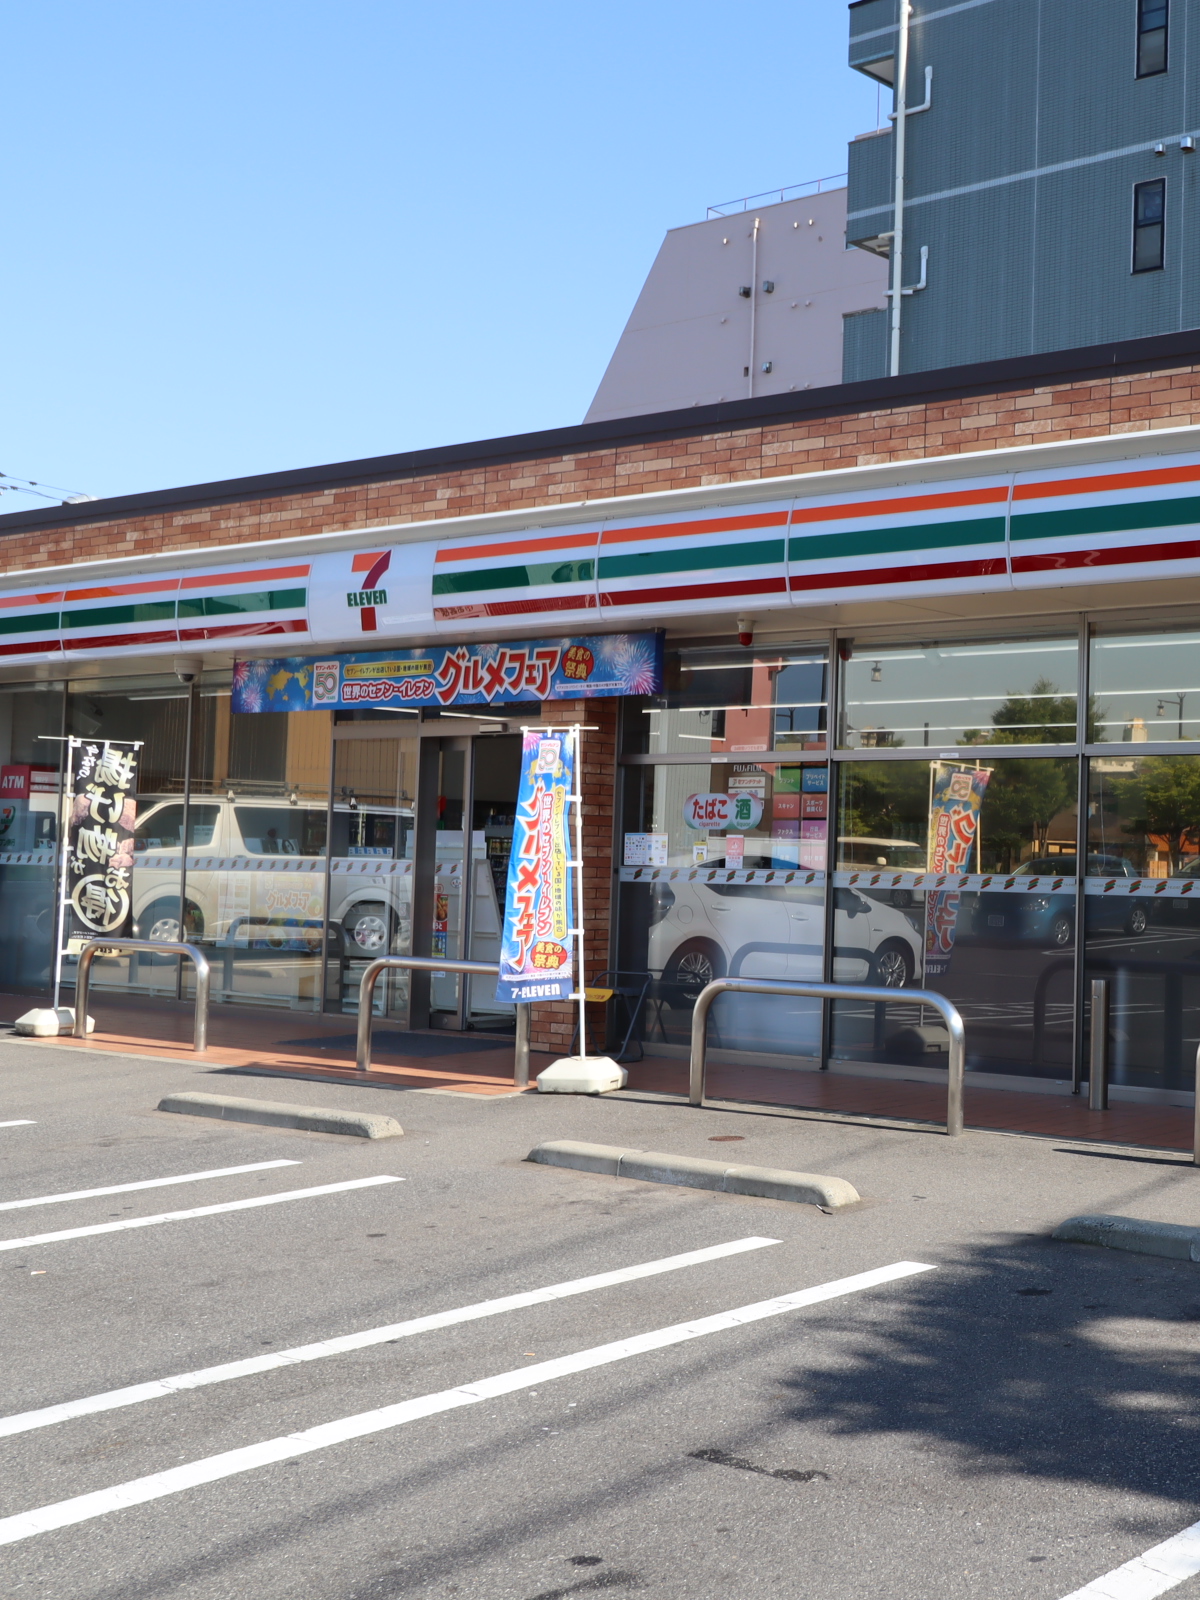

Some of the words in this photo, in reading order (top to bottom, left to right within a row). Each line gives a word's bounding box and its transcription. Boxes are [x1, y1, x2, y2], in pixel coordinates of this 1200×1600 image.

[352, 550, 392, 631] 7
[567, 647, 590, 660] 美食の
[436, 648, 560, 702] グルメフェア
[565, 661, 588, 678] 祭典
[315, 671, 338, 700] 50
[2, 775, 24, 789] ATM
[692, 798, 728, 820] たばこ
[735, 798, 752, 820] 酒
[511, 783, 544, 969] グルメフェア
[266, 890, 311, 912] グルメフェア
[535, 942, 562, 953] 美食の
[534, 954, 560, 969] 祭典
